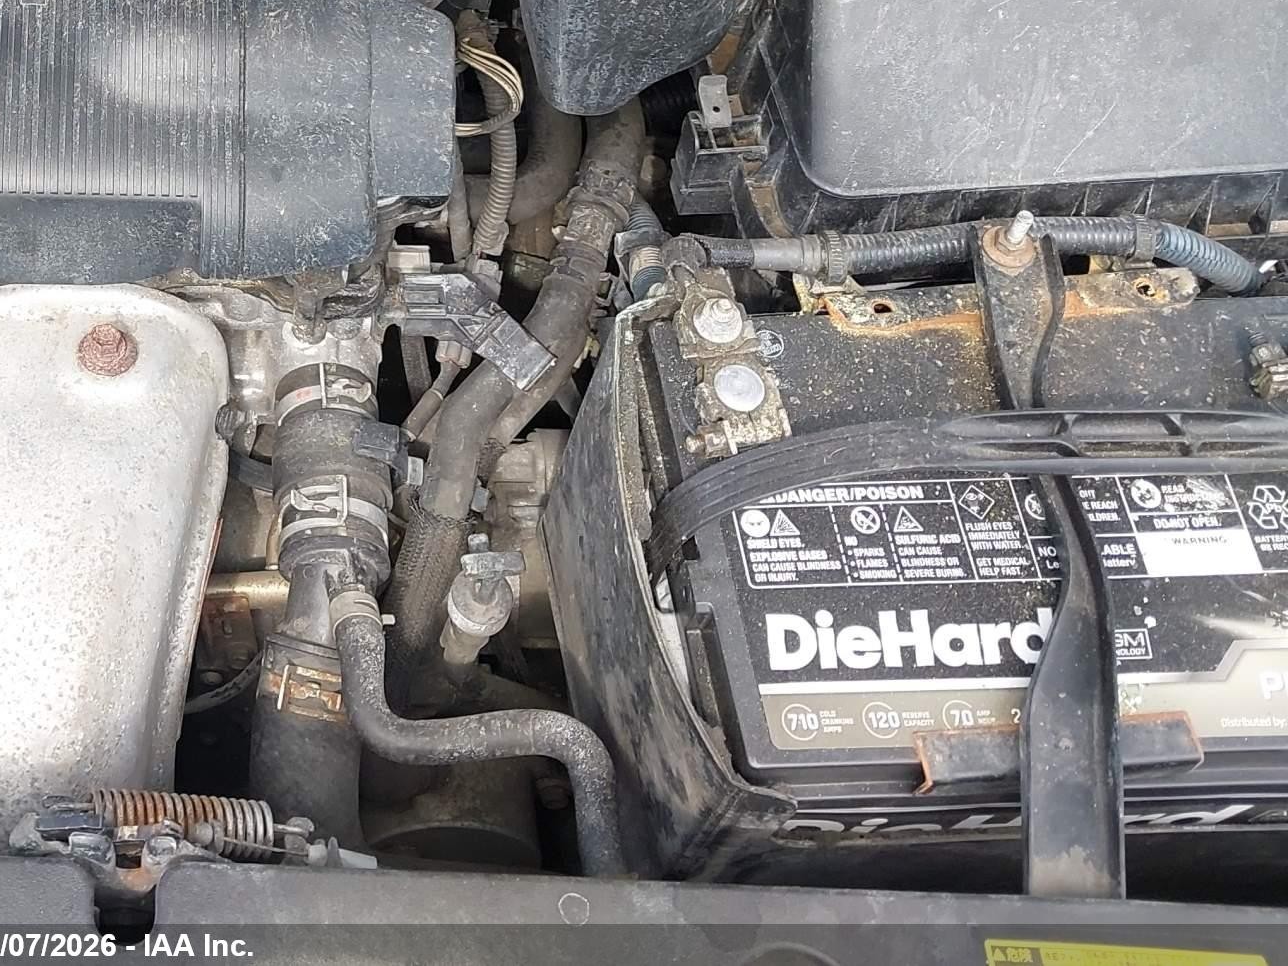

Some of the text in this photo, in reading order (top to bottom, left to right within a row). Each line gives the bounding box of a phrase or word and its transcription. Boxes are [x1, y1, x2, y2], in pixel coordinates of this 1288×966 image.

[775, 485, 924, 504] DANGER/POISON
[1090, 500, 1119, 510] REACH
[965, 521, 1014, 531] FLUSH EYES
[1153, 517, 1168, 529] DO
[1168, 517, 1191, 528] NOT
[894, 533, 962, 546] SULFURIC ACID
[968, 530, 1021, 541] IMMEDIATELY
[1172, 536, 1228, 545] WARNING
[747, 538, 778, 549] SHIELD
[844, 536, 858, 547] NO
[971, 540, 1025, 551] WITH WATER.
[750, 551, 797, 563] EXPLOSIVE
[853, 547, 885, 557] SPARKS
[897, 546, 943, 557] CAN CAUSE
[752, 560, 842, 573] CAN CAUSE BLINDNESS
[856, 559, 889, 569] FLAMES
[900, 557, 960, 568] BLINDNESS OR
[976, 557, 1030, 567] GET MEDICAL
[754, 571, 799, 582] OR INJURY.
[859, 569, 897, 580] SMOKING
[903, 569, 935, 579] SEVERE
[978, 566, 1024, 576] HELP FAST.
[765, 607, 1054, 671] DieHard
[1115, 632, 1146, 647] GM
[1116, 647, 1147, 656] NOLOGY
[819, 710, 837, 718] COLD
[902, 711, 931, 719] RESERVE
[949, 709, 975, 726] 70
[787, 713, 819, 731] 710
[868, 711, 900, 729] 120
[903, 718, 935, 727] CAPACITY
[1220, 716, 1272, 728] Distributed
